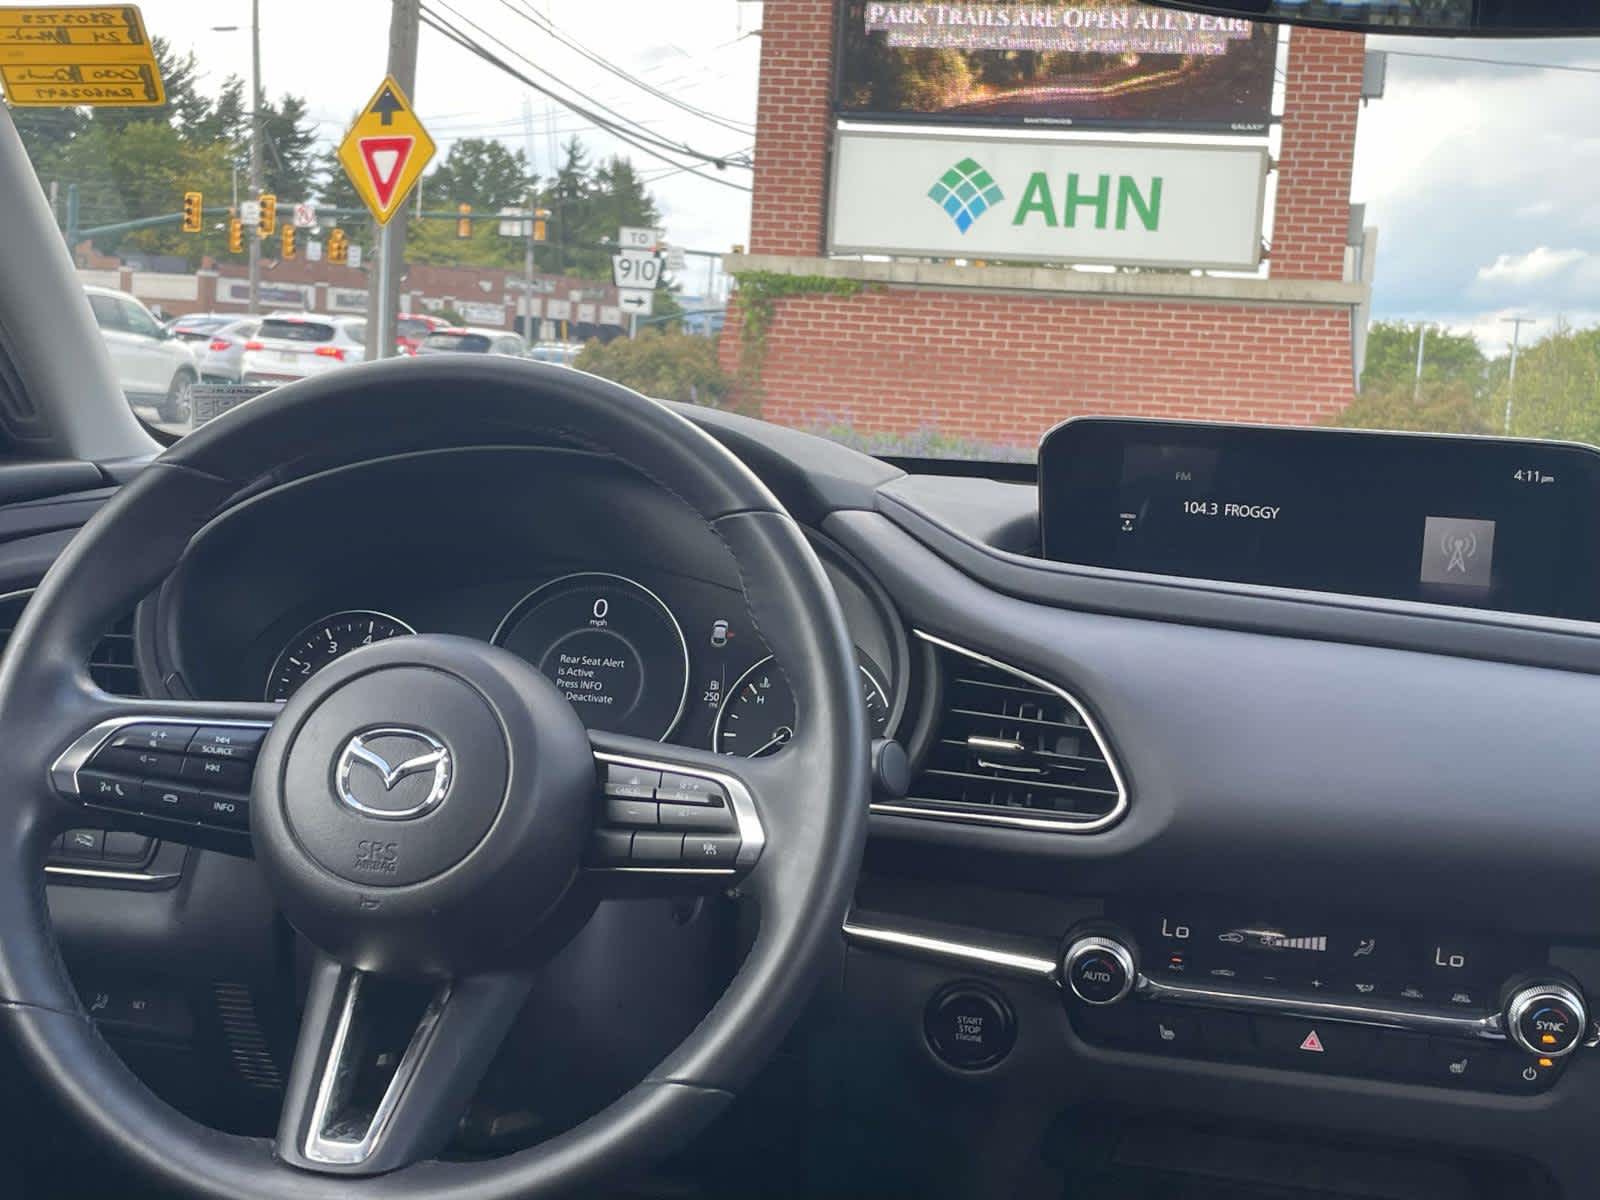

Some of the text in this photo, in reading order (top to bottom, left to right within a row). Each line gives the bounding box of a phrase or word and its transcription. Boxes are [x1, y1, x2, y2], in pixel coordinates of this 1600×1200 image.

[1012, 171, 1164, 232] AHN
[630, 232, 649, 244] TO
[619, 258, 656, 281] 910
[1175, 471, 1192, 481] FM
[1183, 501, 1281, 519] 104.3 FROGGY
[593, 598, 609, 618] 0
[327, 641, 338, 653] 3
[560, 654, 625, 668] Rear Seat Alert
[301, 662, 311, 674] 2
[566, 667, 595, 678] Active
[556, 678, 603, 691] Press INFO
[566, 691, 613, 704] Deactivate
[703, 691, 720, 702] 250
[202, 745, 233, 756] SOURCE
[213, 802, 235, 812] INFO
[1161, 919, 1190, 939] Lo
[1435, 947, 1465, 967] Lo
[1083, 971, 1111, 983] AUTO
[959, 1024, 981, 1034] STOP
[1535, 1020, 1565, 1033] SYNC
